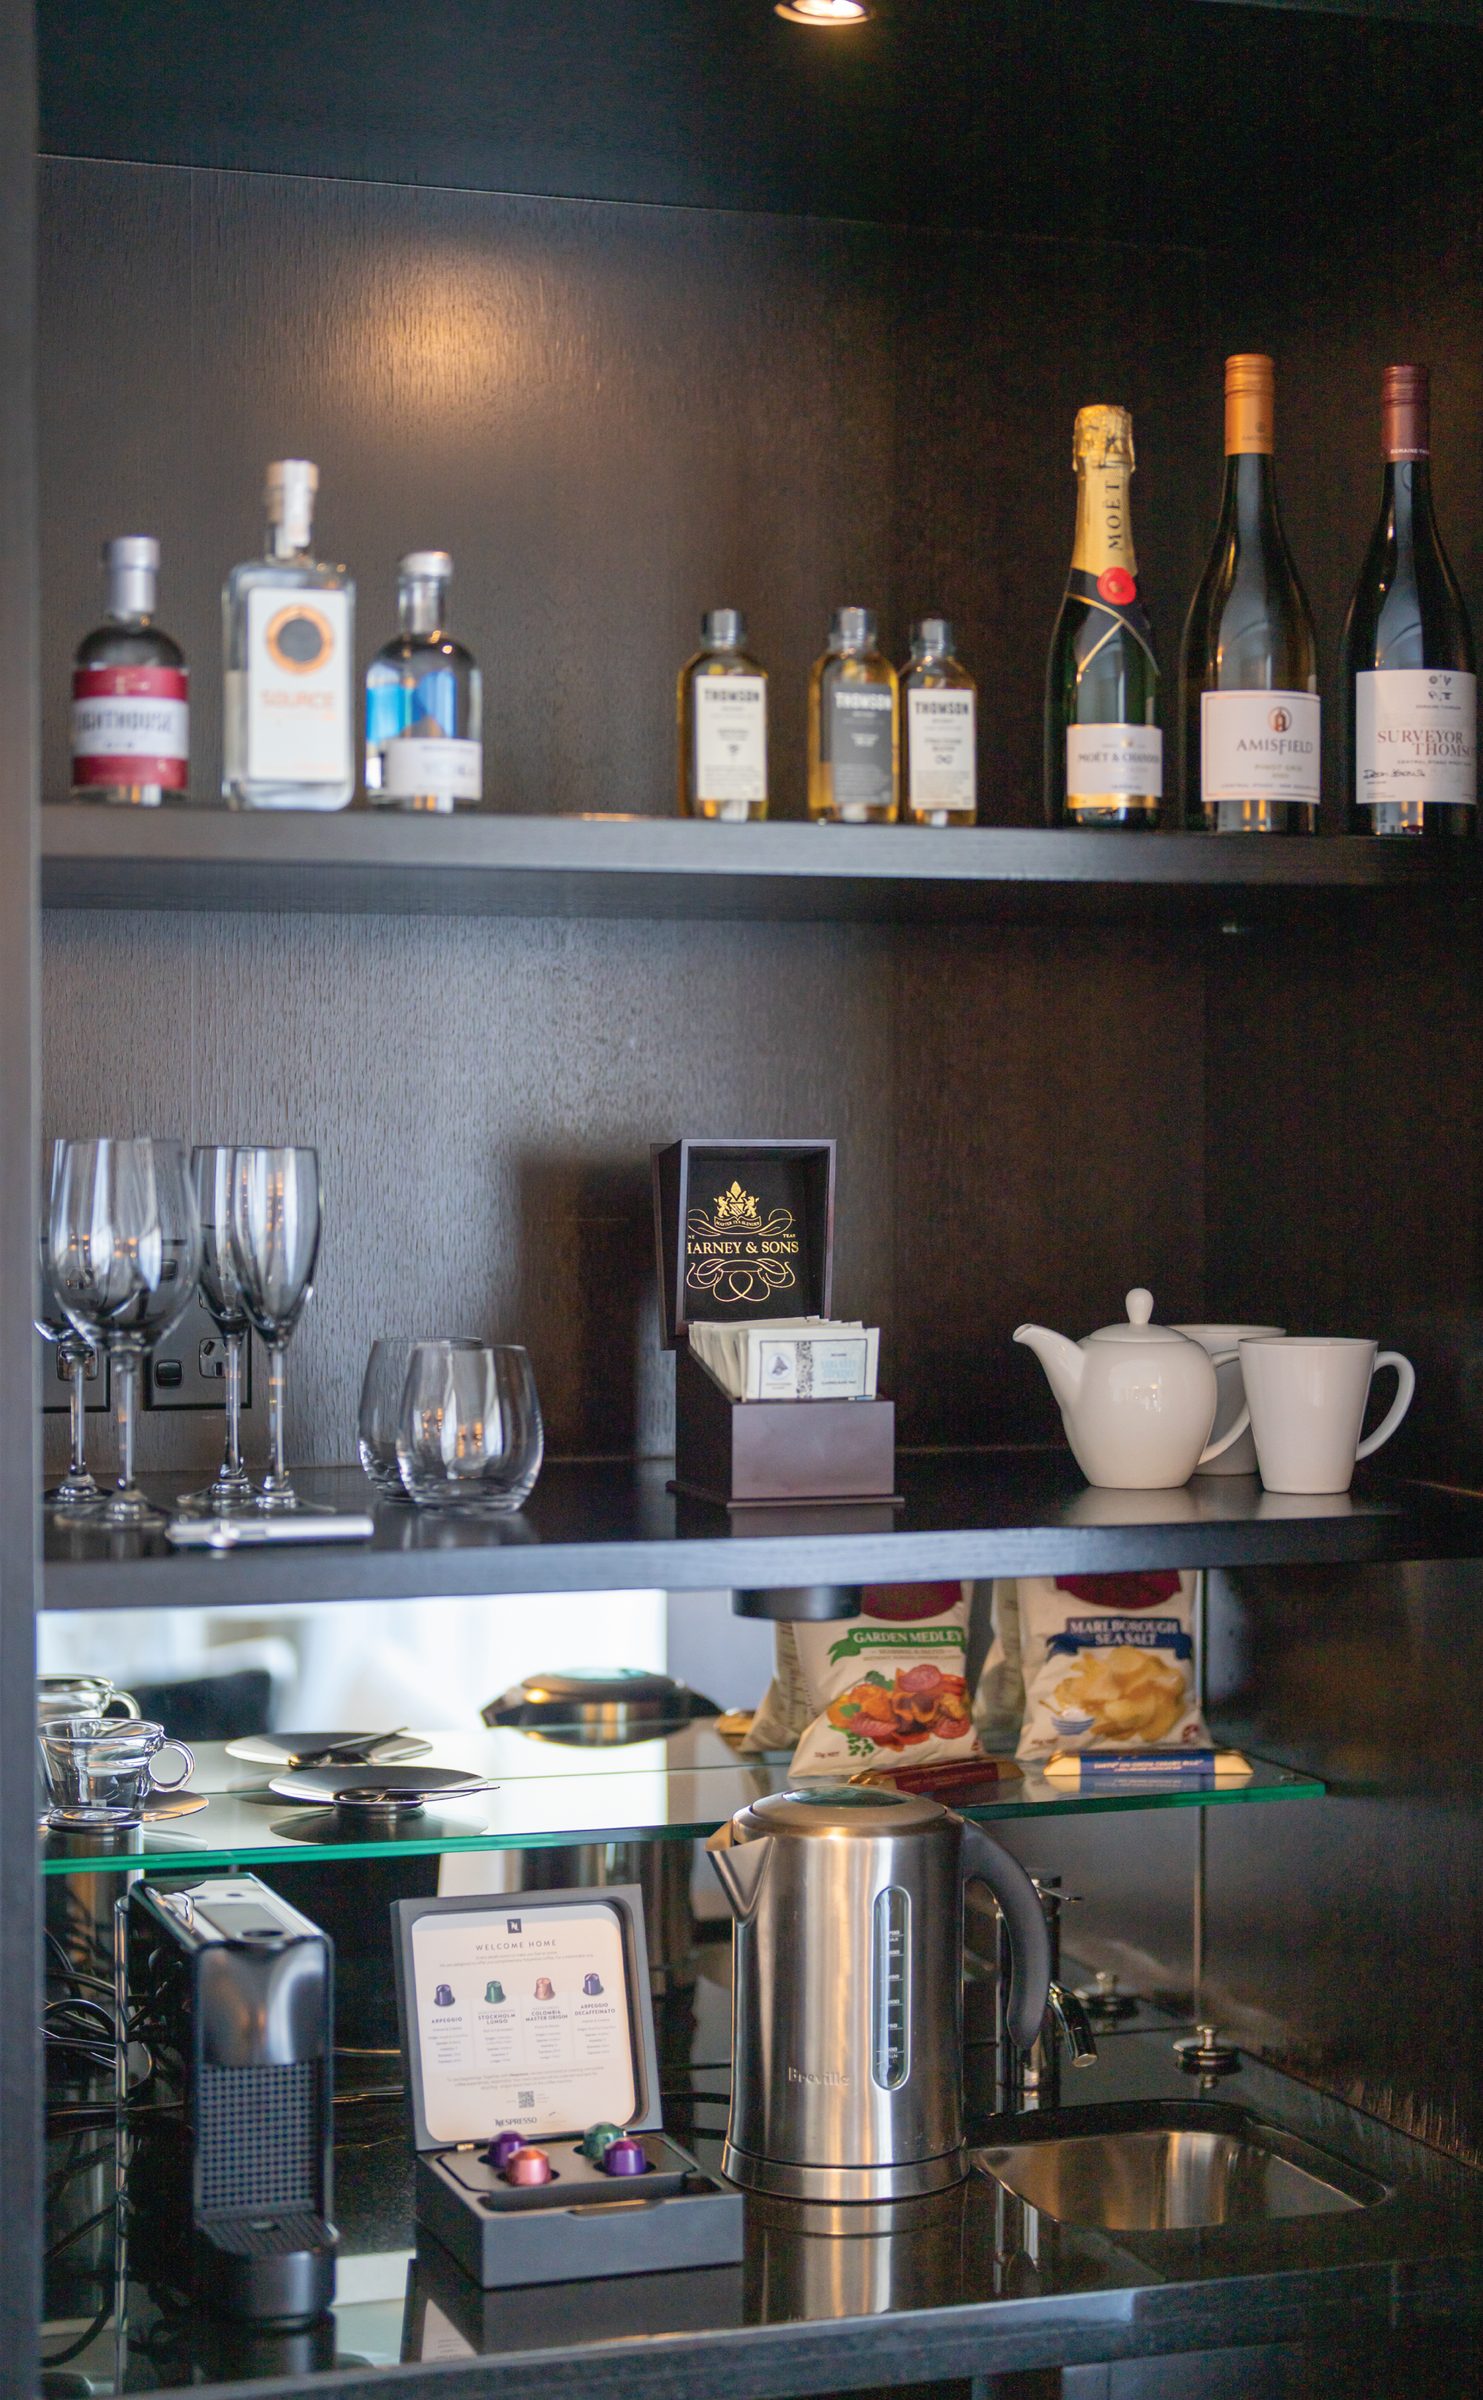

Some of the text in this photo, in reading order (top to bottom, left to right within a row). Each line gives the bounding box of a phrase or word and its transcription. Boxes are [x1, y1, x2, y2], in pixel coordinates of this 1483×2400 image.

[915, 701, 969, 715] THOMSON
[1377, 728, 1464, 744] SURVEYOR
[1236, 738, 1314, 756] AMISFIELD
[745, 1241, 759, 1254] &
[761, 1241, 799, 1254] SONS
[1069, 1619, 1178, 1634] MARLBOROUGH
[853, 1630, 963, 1643] GARDEN MEDLEY
[1095, 1632, 1157, 1646] SEA SALT
[475, 1939, 557, 1951] WELCOME HOME
[788, 2066, 849, 2087] Breville
[494, 2116, 538, 2127] NESPRESSO
